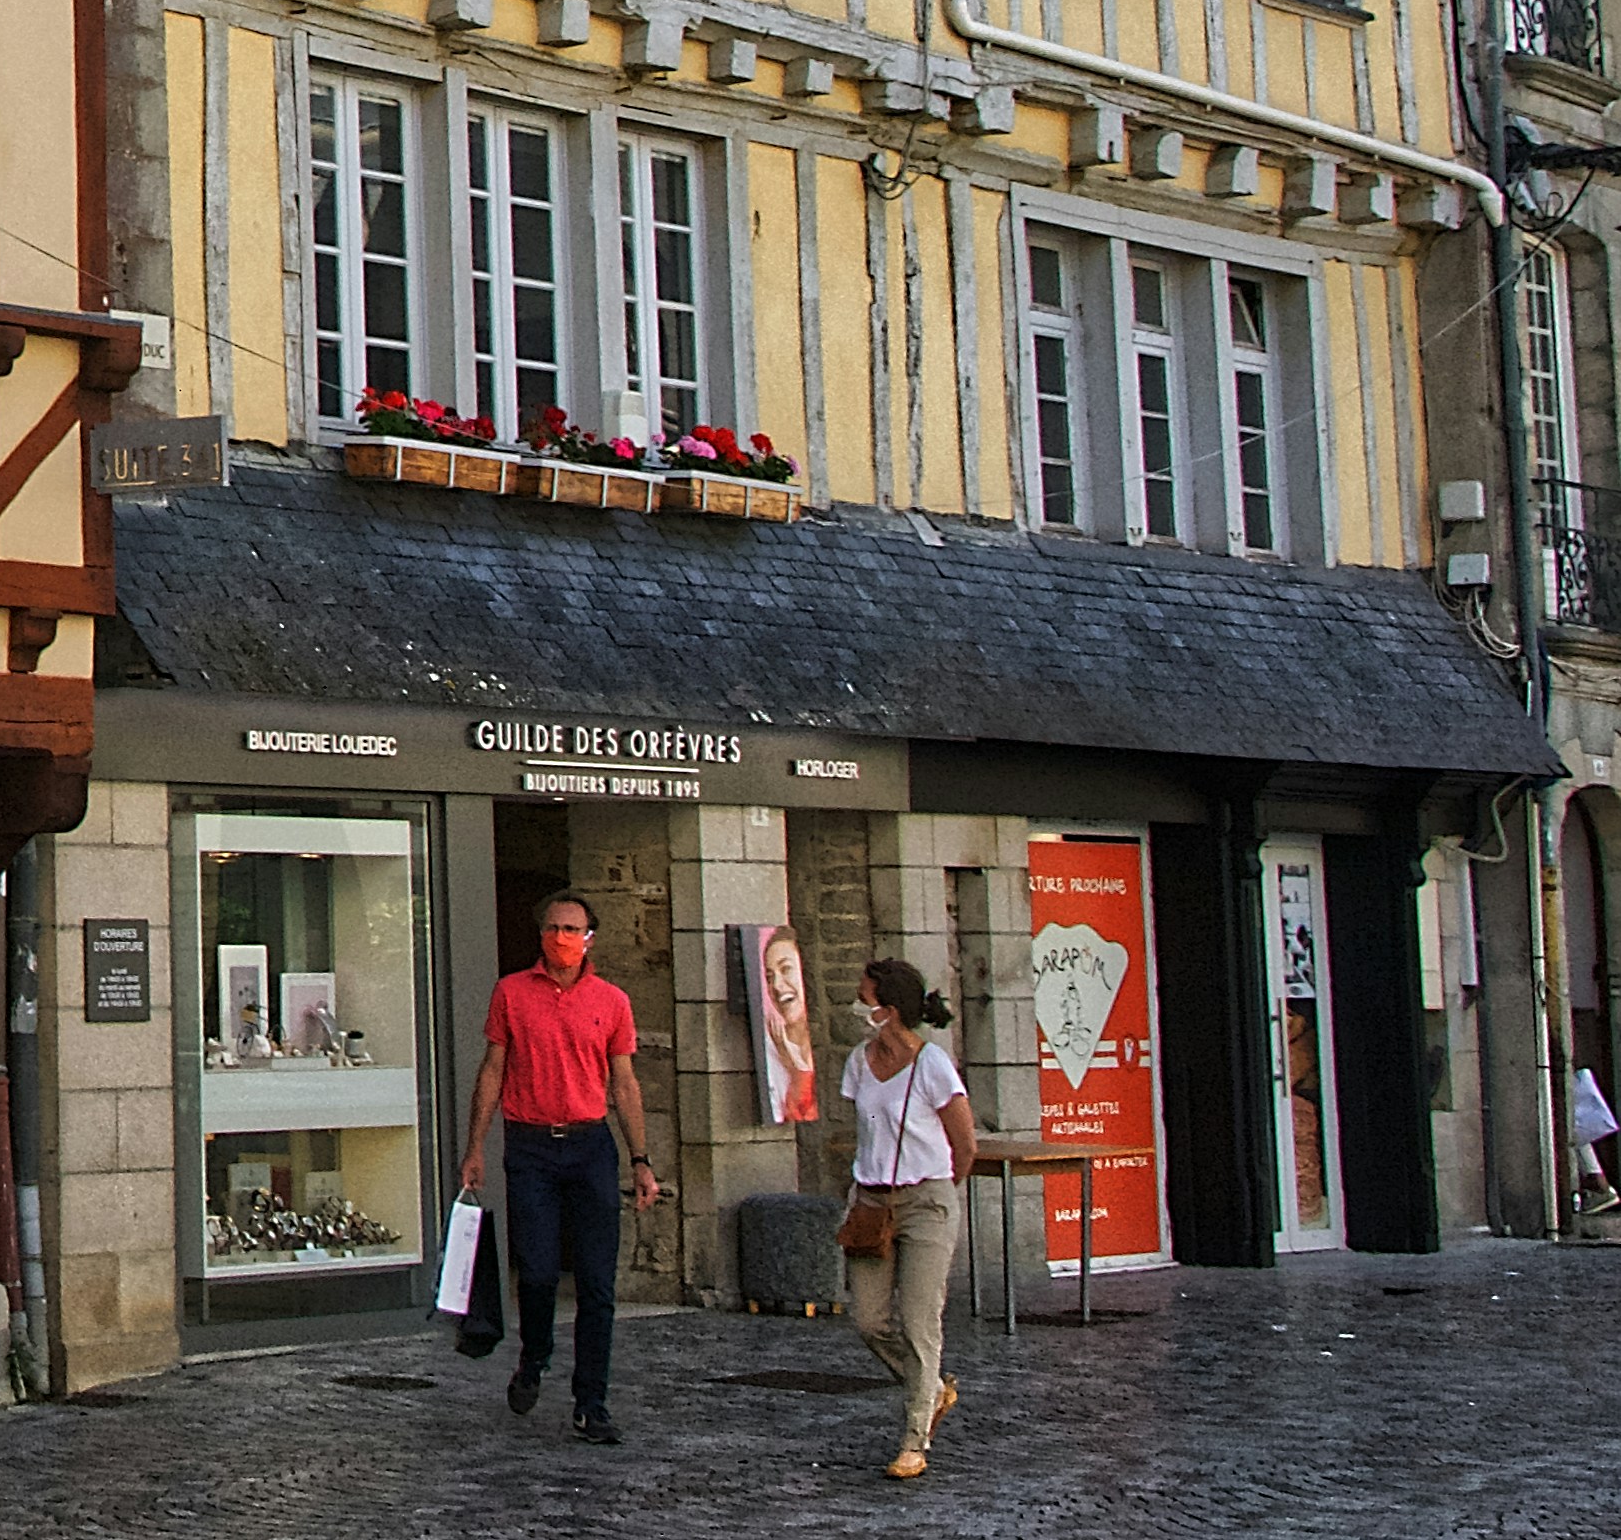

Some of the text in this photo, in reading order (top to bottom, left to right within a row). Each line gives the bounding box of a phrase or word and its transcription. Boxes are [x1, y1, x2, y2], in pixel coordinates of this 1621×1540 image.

[143, 343, 165, 359] DUC
[98, 443, 221, 481] SUITE.31
[248, 730, 397, 756] BIJOUTERIE LOUEDEC
[477, 720, 741, 763] GUILDE DES ORFÈVRES
[796, 759, 859, 779] HORLOGER
[524, 773, 700, 798] BIJOUTIERS DEPUIS 1895
